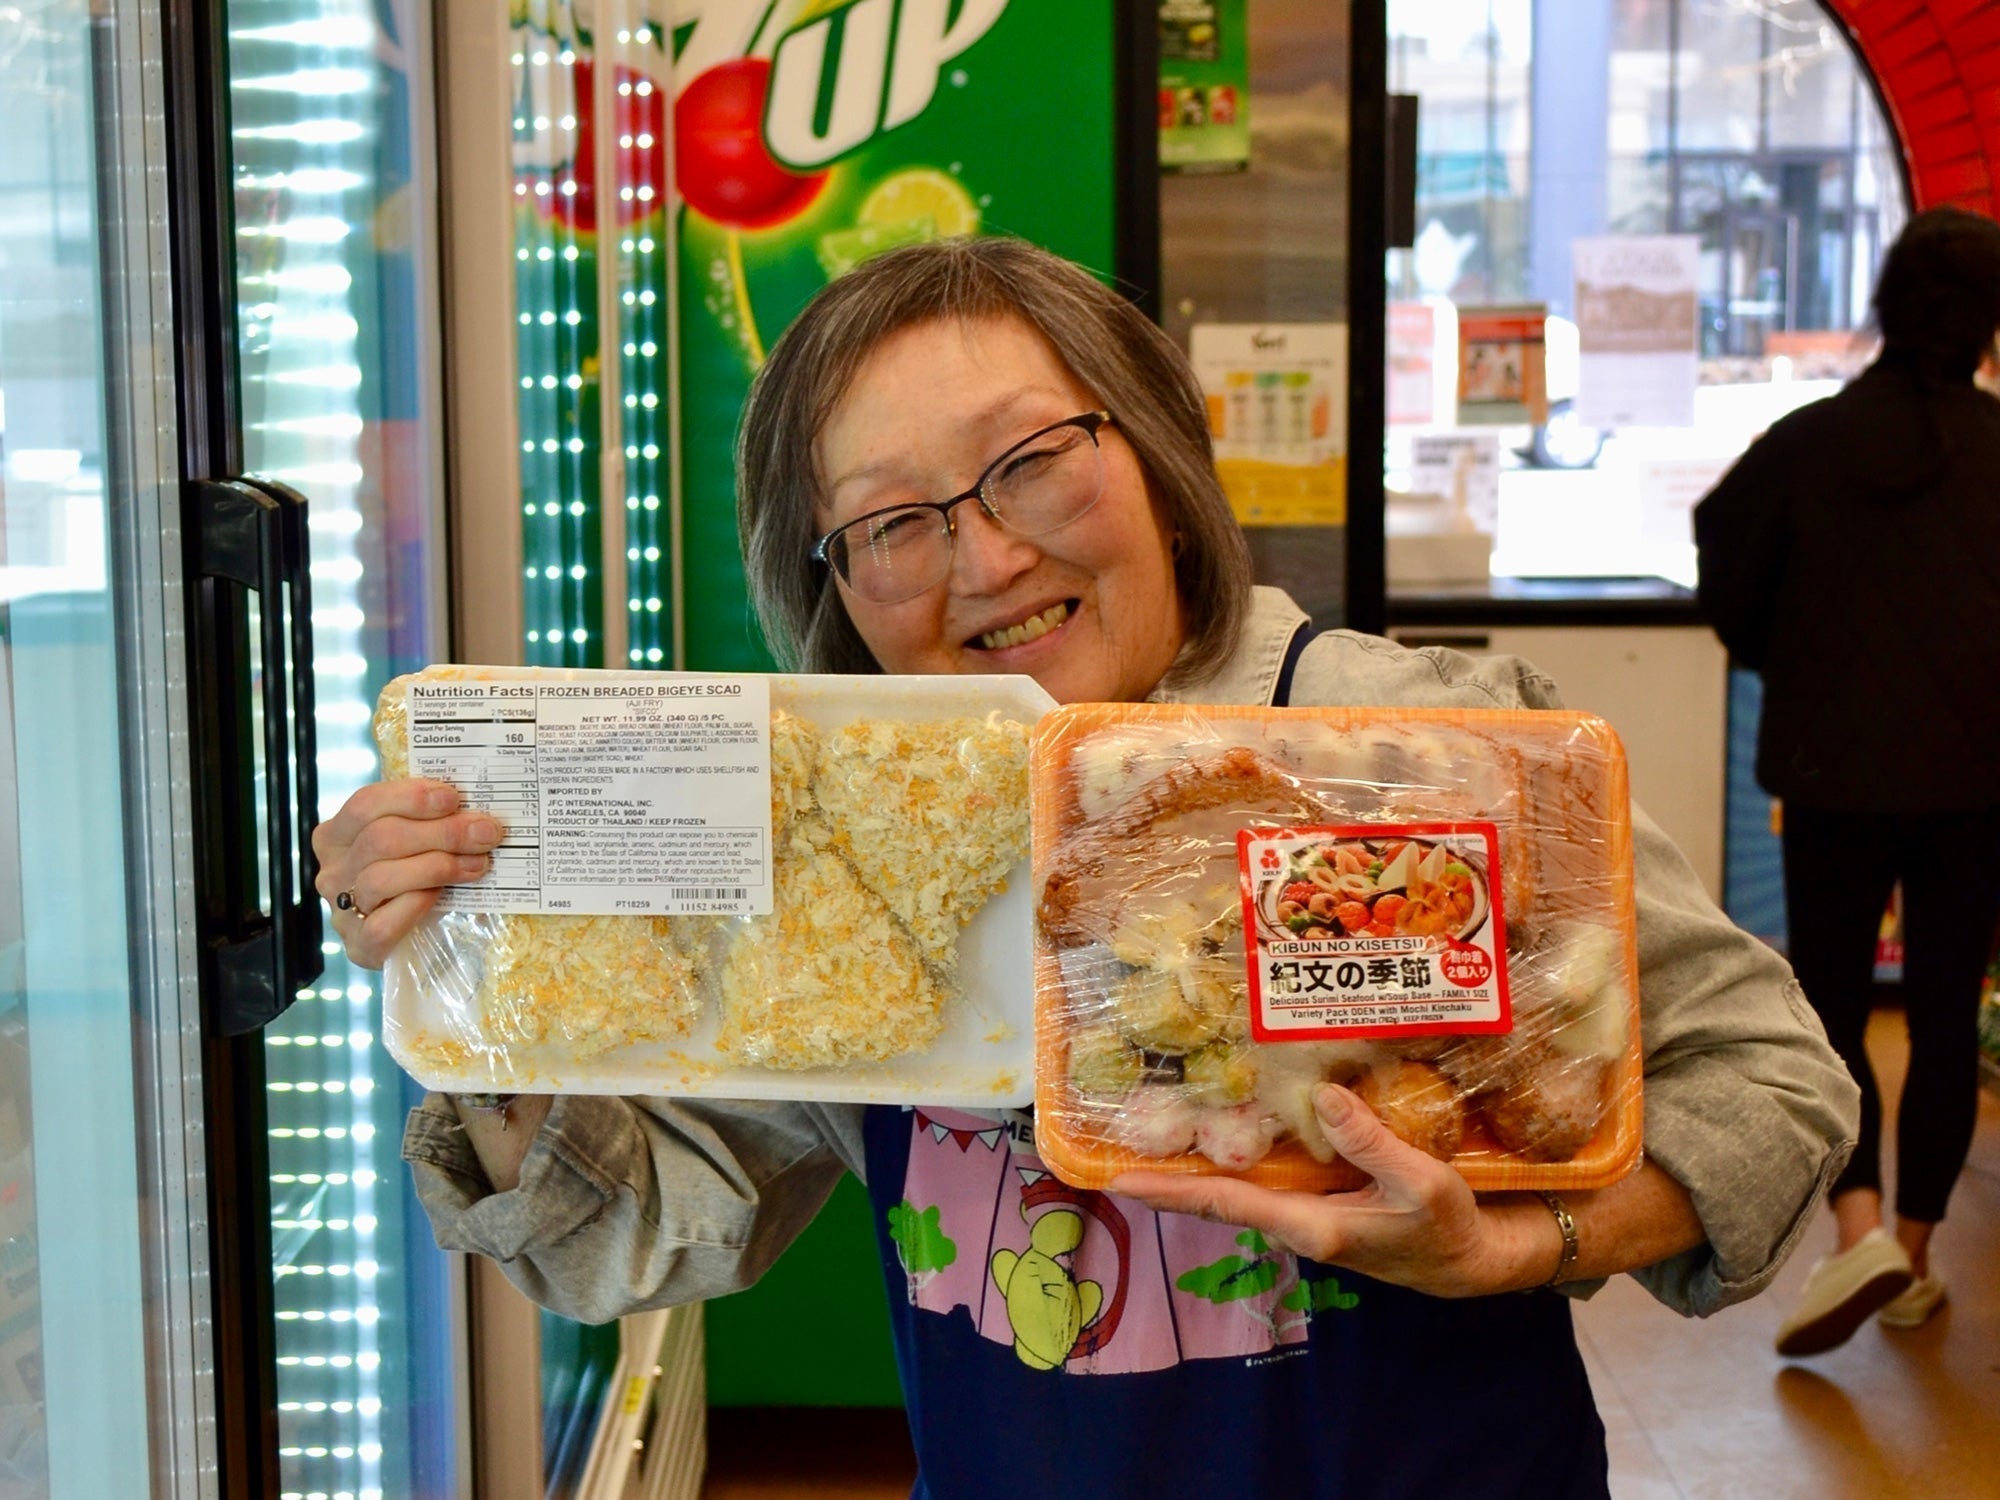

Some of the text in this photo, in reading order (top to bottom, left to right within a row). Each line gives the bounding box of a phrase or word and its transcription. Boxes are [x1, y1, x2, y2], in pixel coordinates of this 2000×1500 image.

[414, 686, 534, 697] Nutrition Facts
[540, 685, 741, 696] FROZEN BREADED BIGEYE SCAD
[643, 700, 663, 708] FRY)
[413, 734, 524, 743] Calories 160
[589, 831, 624, 839] Consuming
[681, 903, 707, 911] 11152
[711, 903, 739, 911] 84985
[1272, 939, 1423, 954] KIBUN NO KISETSU
[1270, 957, 1431, 994] 紀文の季節
[1270, 997, 1309, 1005] Delicious
[1342, 994, 1375, 1002] Seafood
[1378, 993, 1408, 1001] w/Soup
[1442, 990, 1470, 998] FAMILY
[1291, 1010, 1323, 1019] Variety
[1327, 1008, 1348, 1017] Pack
[1351, 1007, 1375, 1015] ODEN
[1400, 1005, 1428, 1013] Mochi
[1432, 1003, 1472, 1012] Kinchaku
[1003, 1119, 1036, 1144] ME
